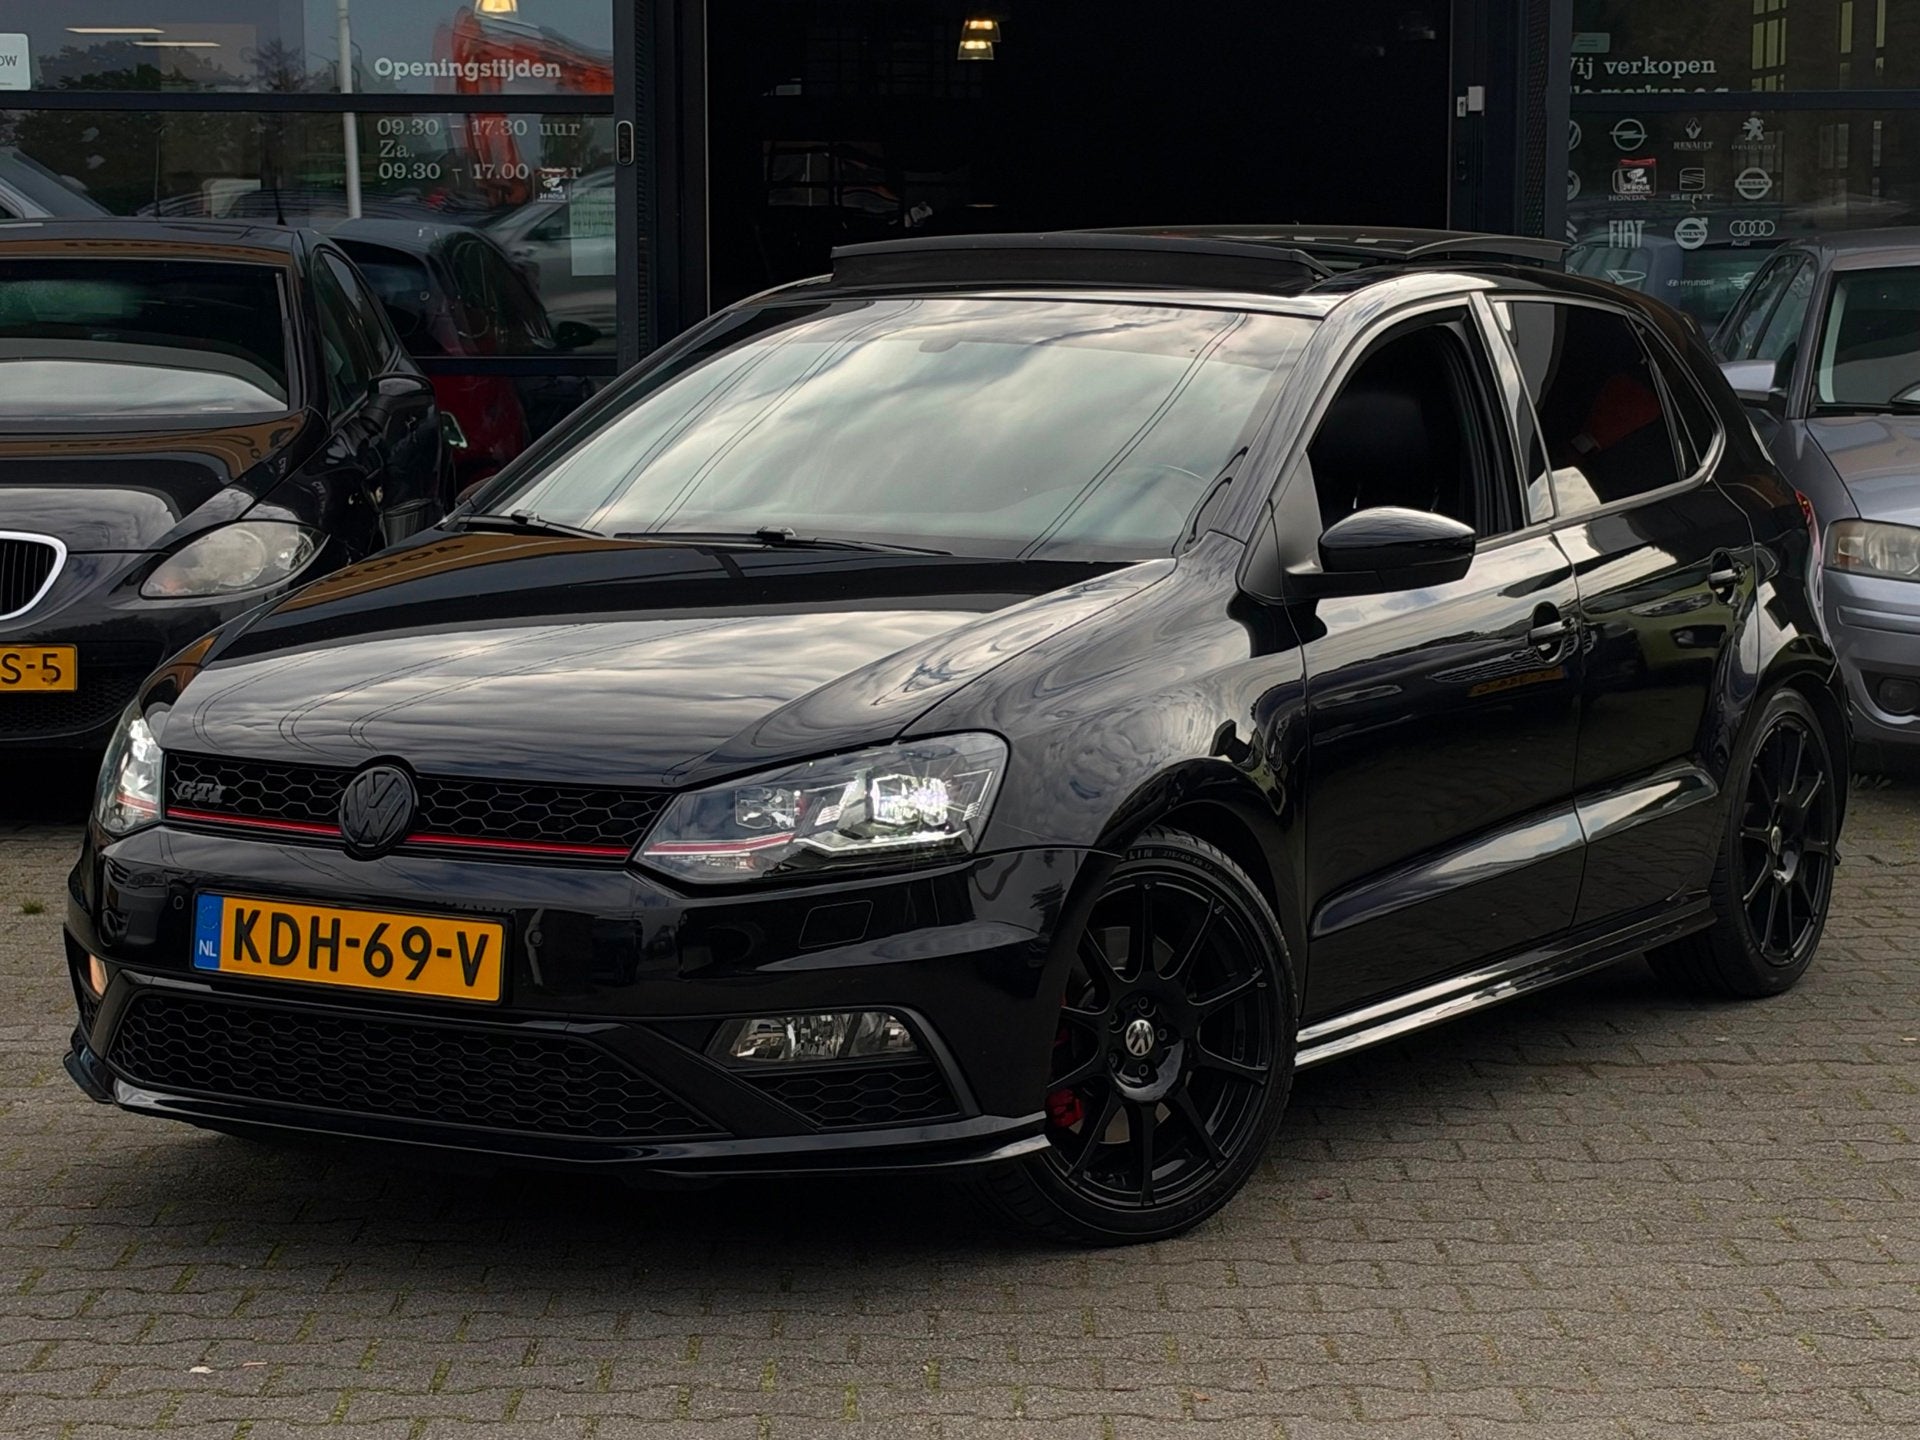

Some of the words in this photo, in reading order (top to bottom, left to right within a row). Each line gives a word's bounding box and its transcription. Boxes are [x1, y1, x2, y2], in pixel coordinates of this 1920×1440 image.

[374, 57, 562, 82] Openingstijden
[1604, 56, 1717, 80] verkopen
[377, 118, 439, 136] 09.30
[472, 119, 528, 136] 17.30
[539, 121, 580, 136] uur
[379, 139, 416, 158] Za.
[1673, 141, 1714, 150] RENAULT
[378, 162, 441, 179] 09.30
[472, 162, 529, 180] 17.00
[1670, 193, 1714, 201] SEAT
[1608, 219, 1646, 249] FIAT
[1676, 230, 1706, 238] VOLVO
[0, 653, 62, 685] S-5
[177, 780, 227, 804] GTI
[199, 940, 217, 957] NL
[232, 907, 490, 988] KDH-69-V
